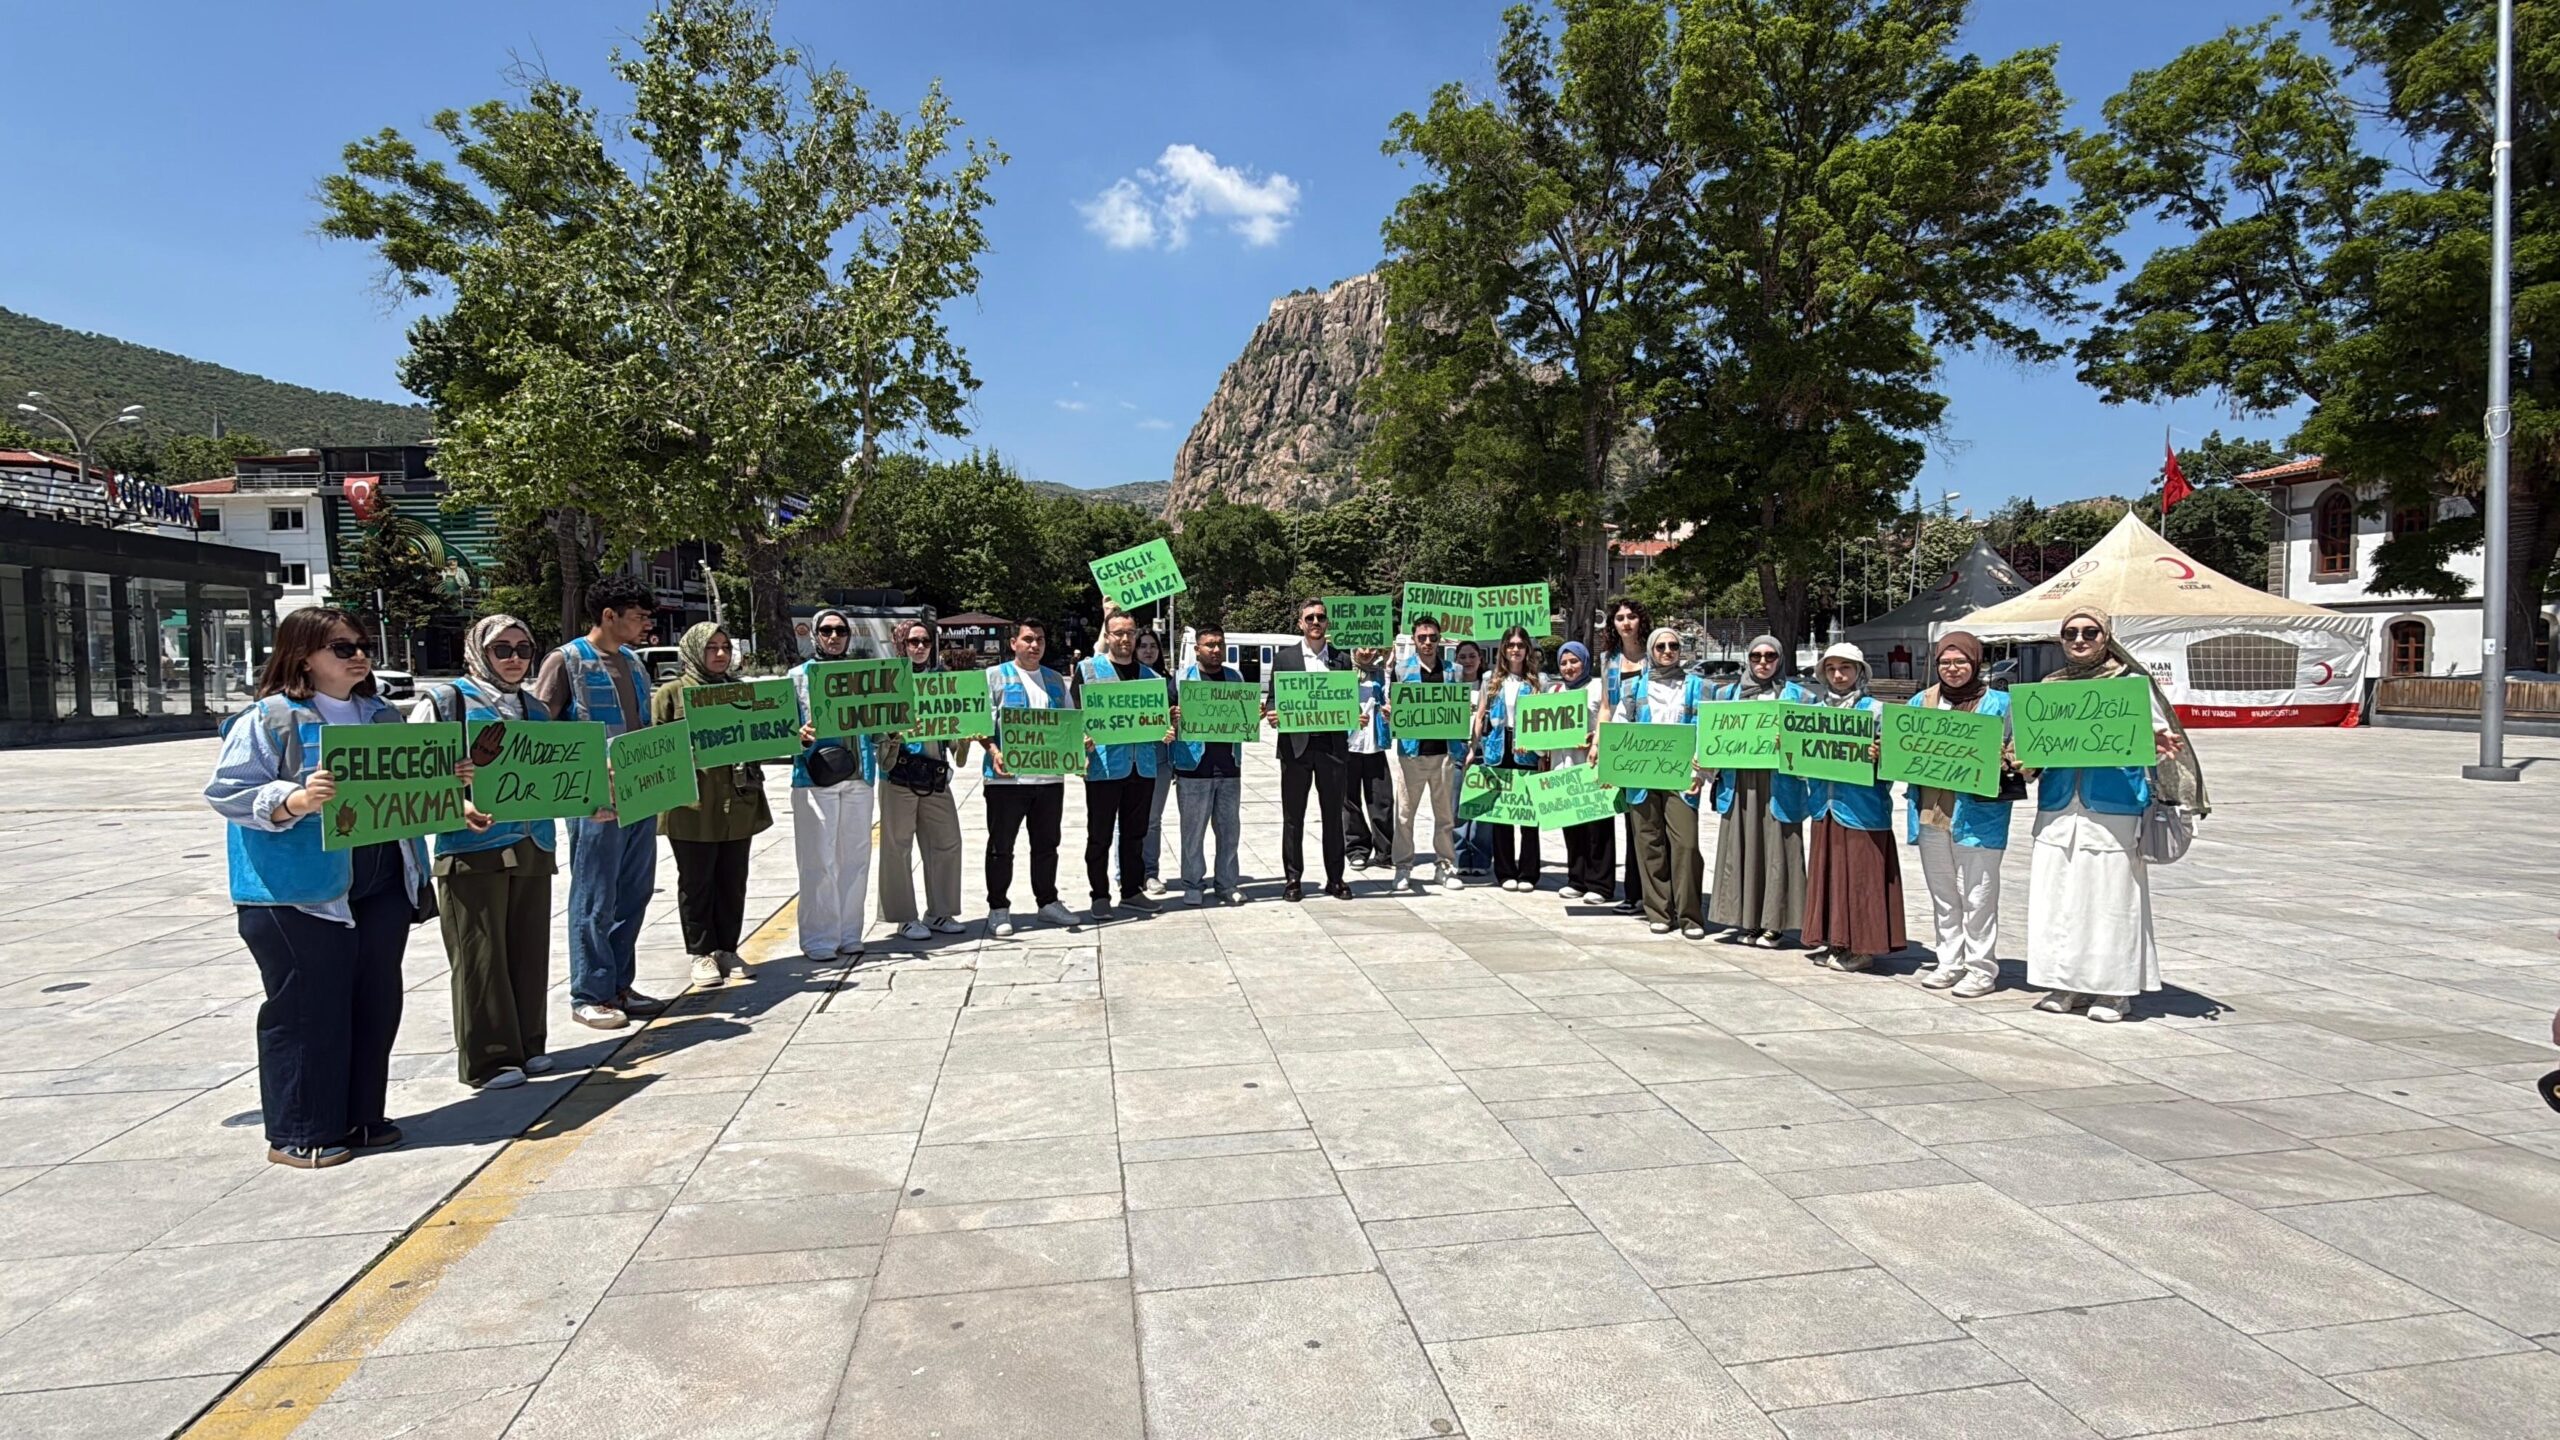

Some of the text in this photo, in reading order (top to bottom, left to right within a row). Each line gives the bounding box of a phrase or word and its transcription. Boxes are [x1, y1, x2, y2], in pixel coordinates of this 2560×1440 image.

[1477, 585, 1543, 608] SEVGİYE
[1332, 603, 1386, 618] HER DOZ
[1483, 609, 1536, 629] TUTUN
[1334, 631, 1384, 646] GÖZYAŞI
[2150, 662, 2172, 670] KAN
[825, 661, 899, 698] GENÇLİK
[1279, 674, 1328, 690] TEMİZ
[919, 692, 985, 715] MADDEYİ
[1086, 692, 1164, 708] BİR KEREDEN
[1182, 687, 1208, 701] ÖNCE
[1308, 688, 1354, 700] GELECEK
[1397, 686, 1470, 704] AİLENLE
[1199, 703, 1239, 717] SONRA
[2075, 690, 2139, 720] DEĞİL
[2211, 710, 2237, 718] VARSIN
[1086, 718, 1106, 730] ÇOK
[1109, 714, 1135, 731] ŞEY
[1521, 704, 1583, 733] HAYIR!
[1711, 713, 1752, 731] HAYAT
[1896, 710, 1983, 739] GÜÇ BİZDE
[751, 719, 797, 741] BIRAK
[1004, 729, 1045, 745] OLMA
[2027, 723, 2136, 756] YAŞAMI SEÇ!
[501, 733, 585, 765] MADDEYE
[1610, 731, 1679, 752] MADDEYE
[1900, 735, 1984, 763] GELECEK
[326, 739, 457, 782] GELECEĞİNİ
[1063, 751, 1085, 771] OL
[553, 769, 591, 804] DE!
